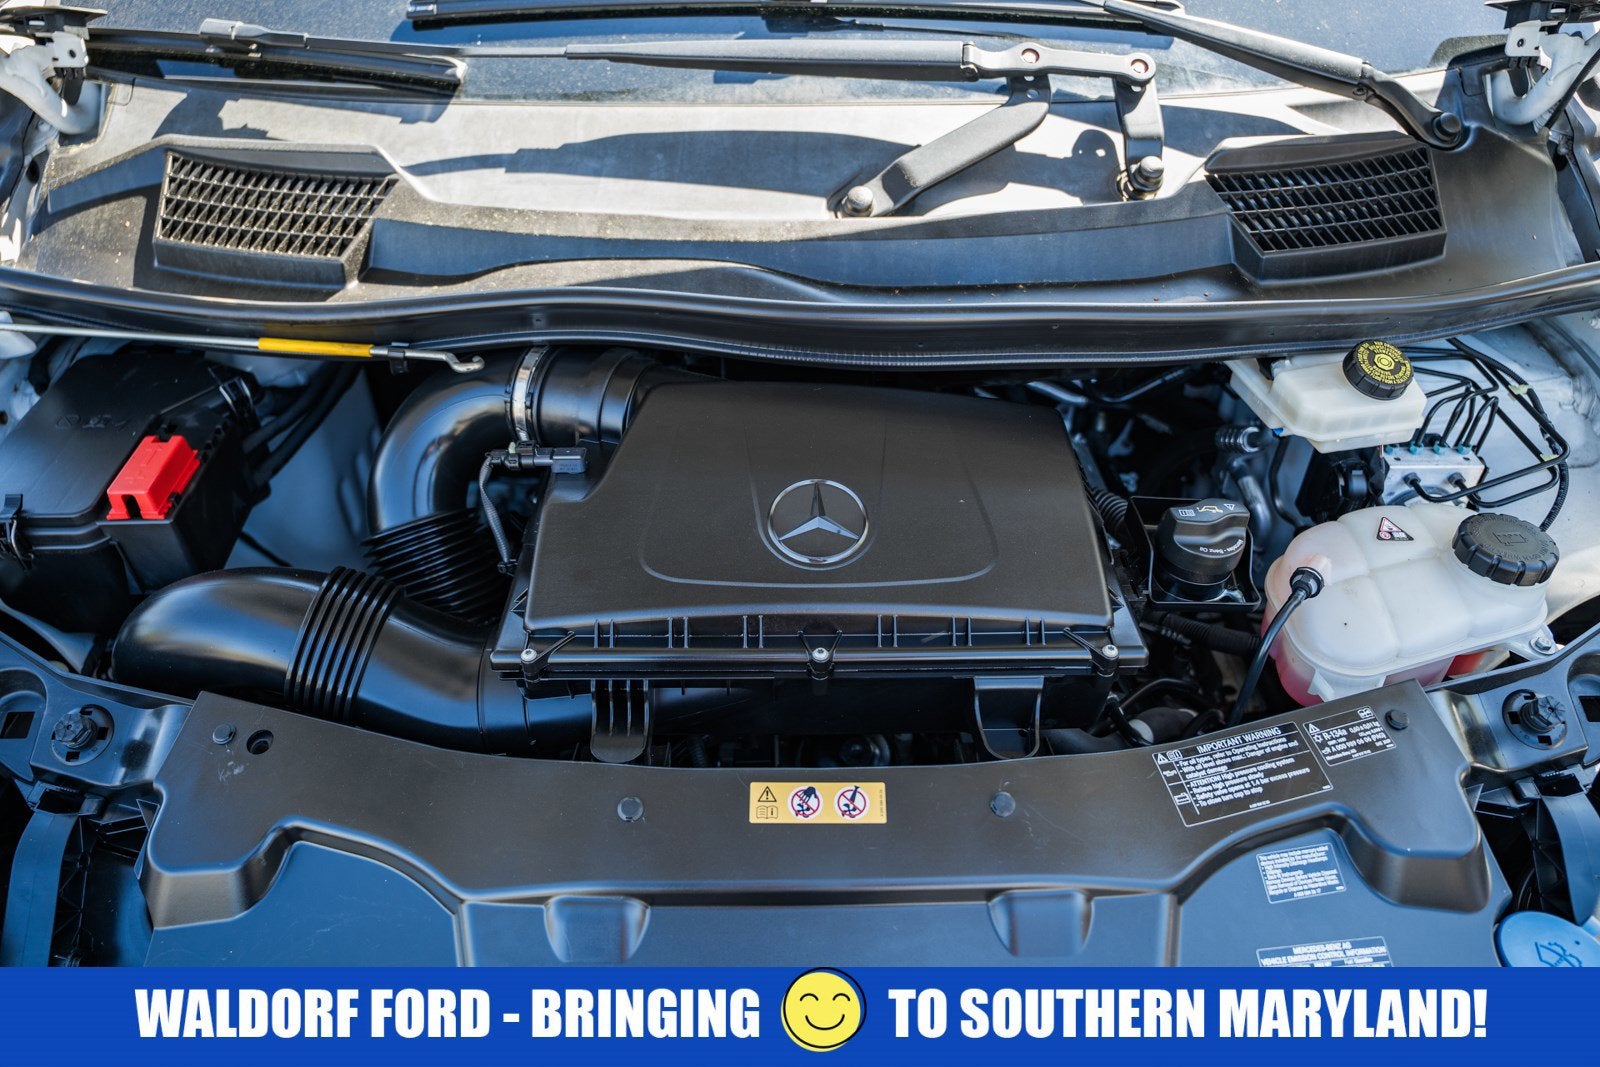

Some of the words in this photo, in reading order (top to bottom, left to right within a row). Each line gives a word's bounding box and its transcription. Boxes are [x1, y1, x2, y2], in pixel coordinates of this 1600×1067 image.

[1196, 736, 1243, 754] IMPORTANT
[1242, 727, 1281, 742] WARNING
[1322, 729, 1348, 740] R-134a
[1202, 760, 1216, 768] level
[1216, 757, 1232, 765] above
[1246, 749, 1265, 758] Danger
[1271, 743, 1288, 752] engine
[1231, 744, 1258, 754] Operating
[1185, 770, 1208, 780] catalyst
[1206, 765, 1229, 775] damage
[1190, 775, 1222, 788] ATTENTION!
[1234, 767, 1257, 777] pressure
[1257, 762, 1277, 771] cooling
[1275, 758, 1295, 767] system
[1224, 776, 1248, 787] pressure
[1247, 772, 1264, 781] slowly
[1195, 792, 1214, 801] Safety
[1213, 788, 1229, 796] valve
[1228, 784, 1245, 793] opens
[1287, 768, 1310, 778] pressure
[1207, 797, 1222, 805] close
[1250, 786, 1263, 794] stop
[1261, 956, 1286, 966] VEHICLE
[1287, 953, 1316, 963] EMISSION
[1317, 950, 1345, 960] CONTROL
[1345, 946, 1387, 956] INFORMATION
[1293, 943, 1342, 955] MERCEDES-BENZ
[1342, 941, 1352, 950] AG
